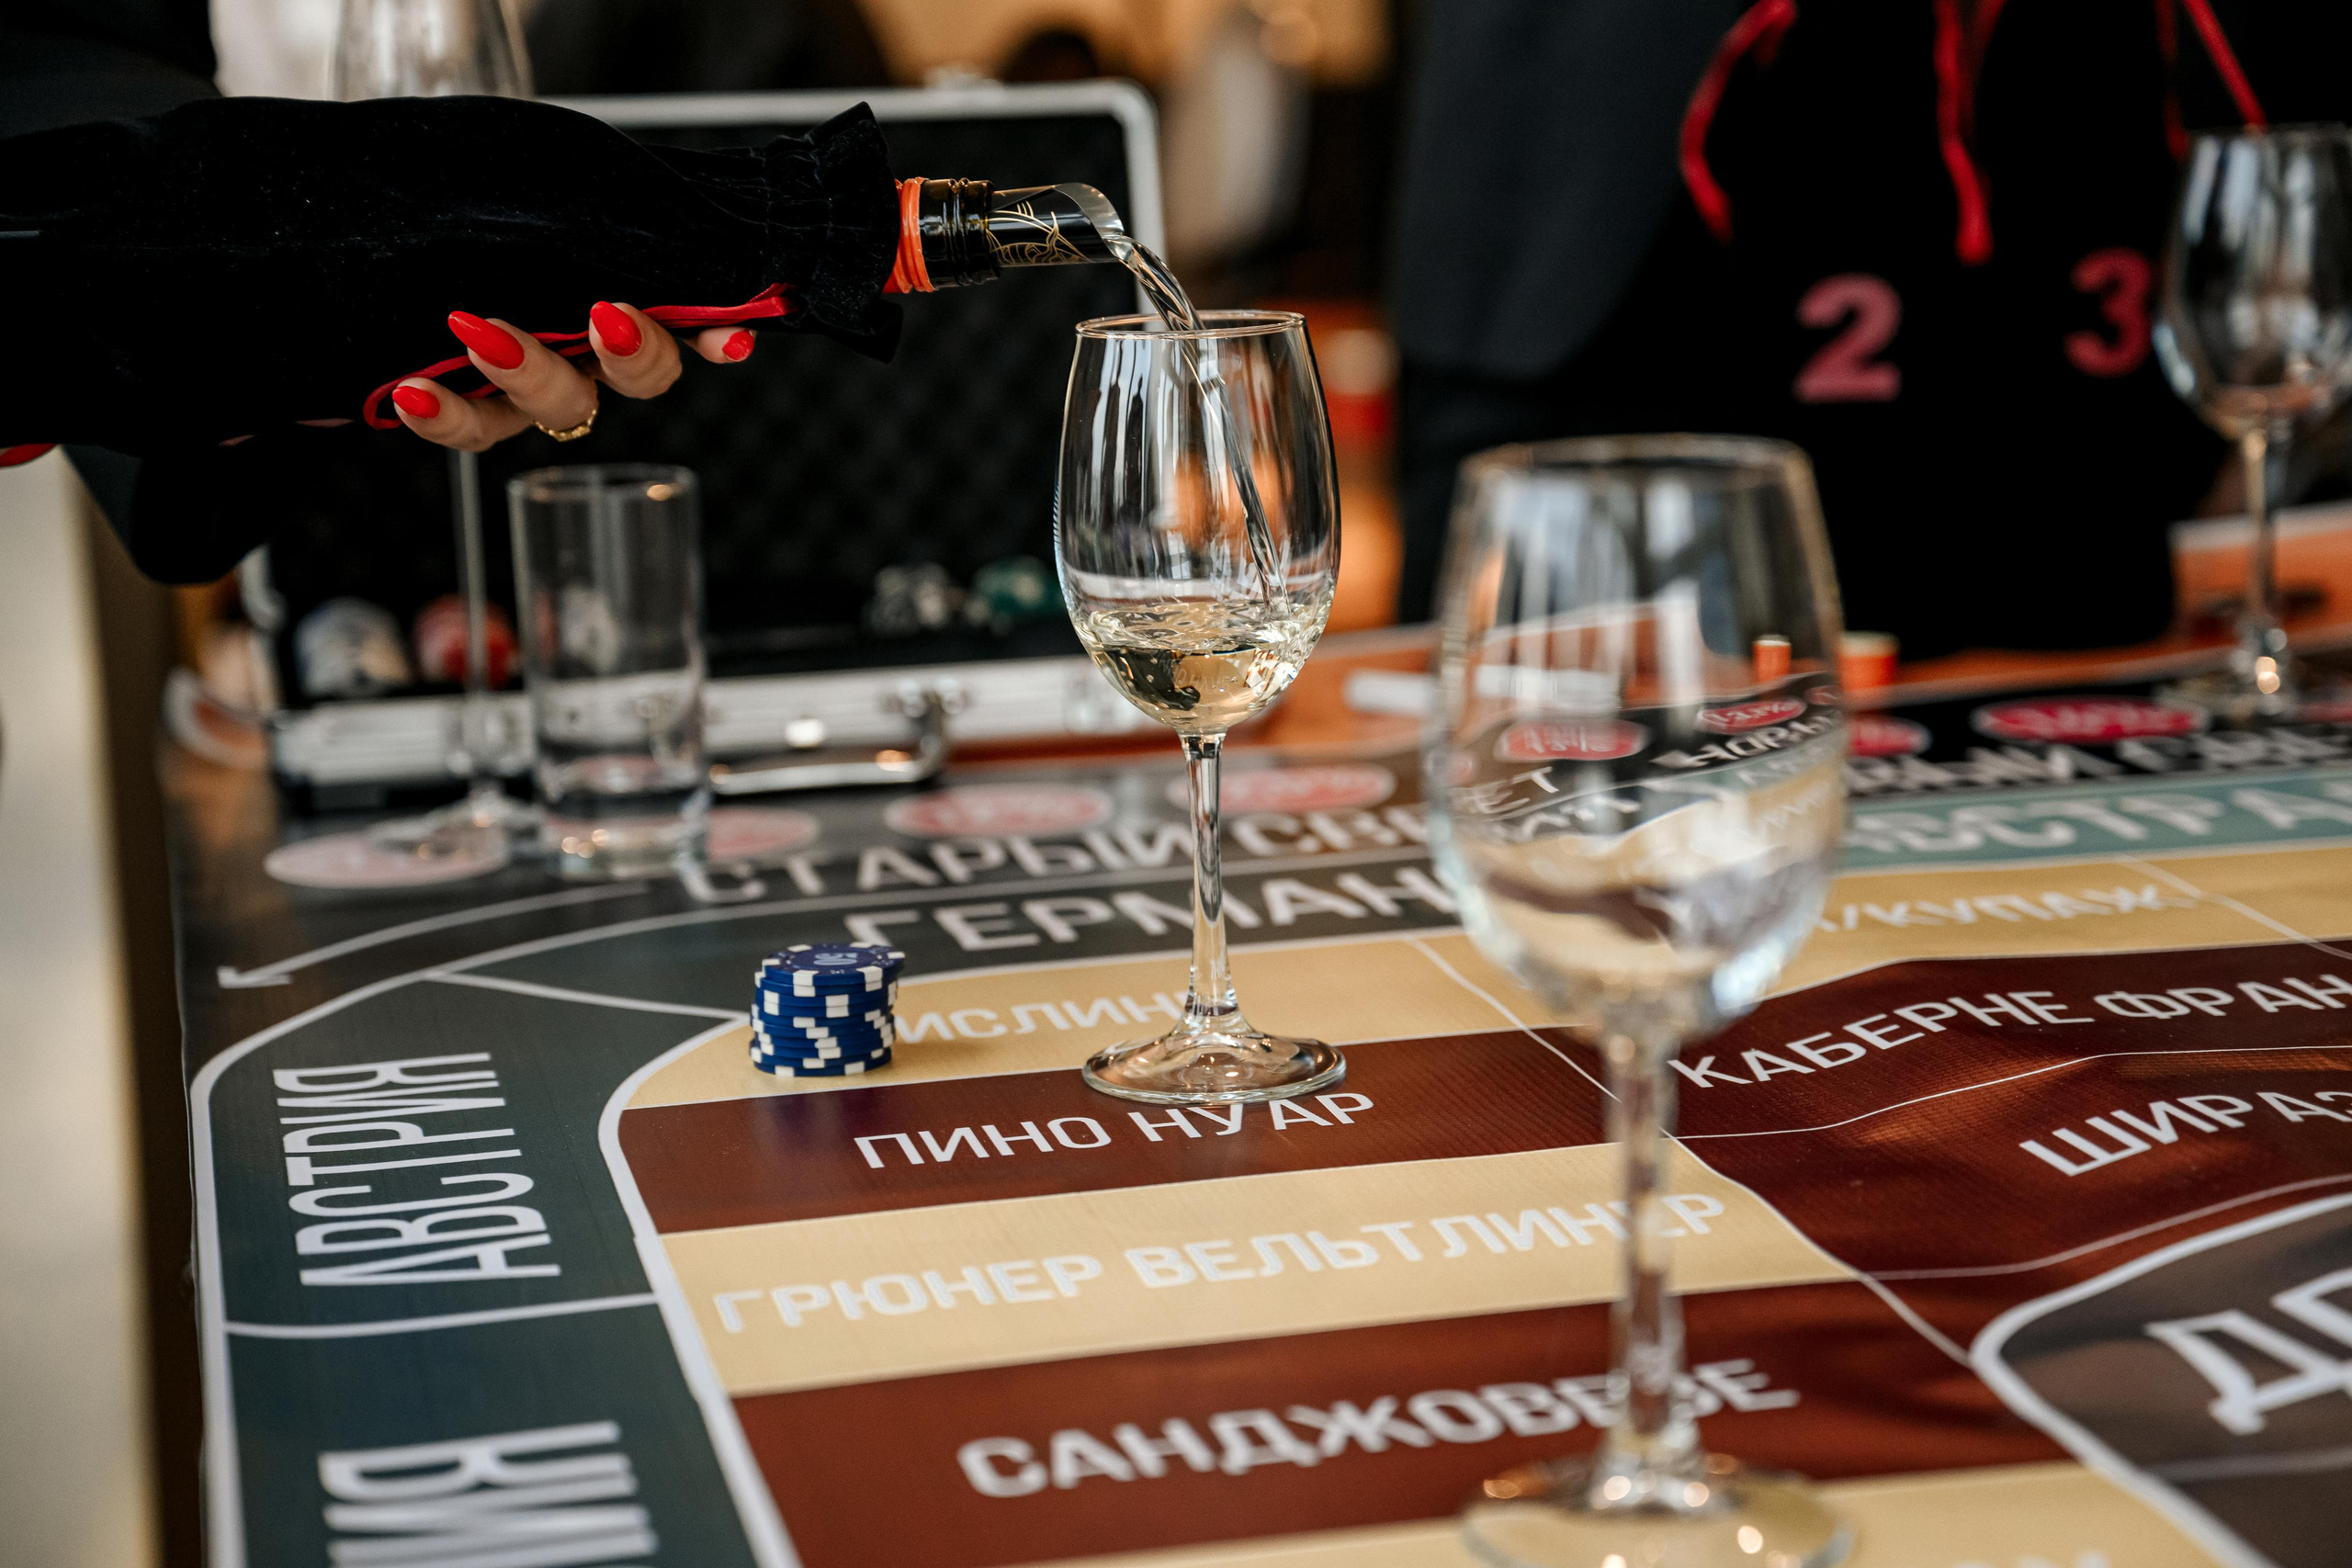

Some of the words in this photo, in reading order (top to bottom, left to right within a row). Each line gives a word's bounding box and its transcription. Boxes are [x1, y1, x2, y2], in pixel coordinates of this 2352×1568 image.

[1795, 274, 1903, 403] 2
[2064, 247, 2152, 377] 3
[843, 866, 1461, 952] ГЕРМАН
[1814, 886, 2201, 931] /КУПАЖ
[895, 992, 1187, 1043] ИСЛИН
[1668, 990, 2096, 1089] КАБЕРНЕ
[273, 1052, 560, 1286] АВСТРИЯ
[854, 1116, 1112, 1168] ПИНО
[713, 1254, 1103, 1334] ГРЮНЕР
